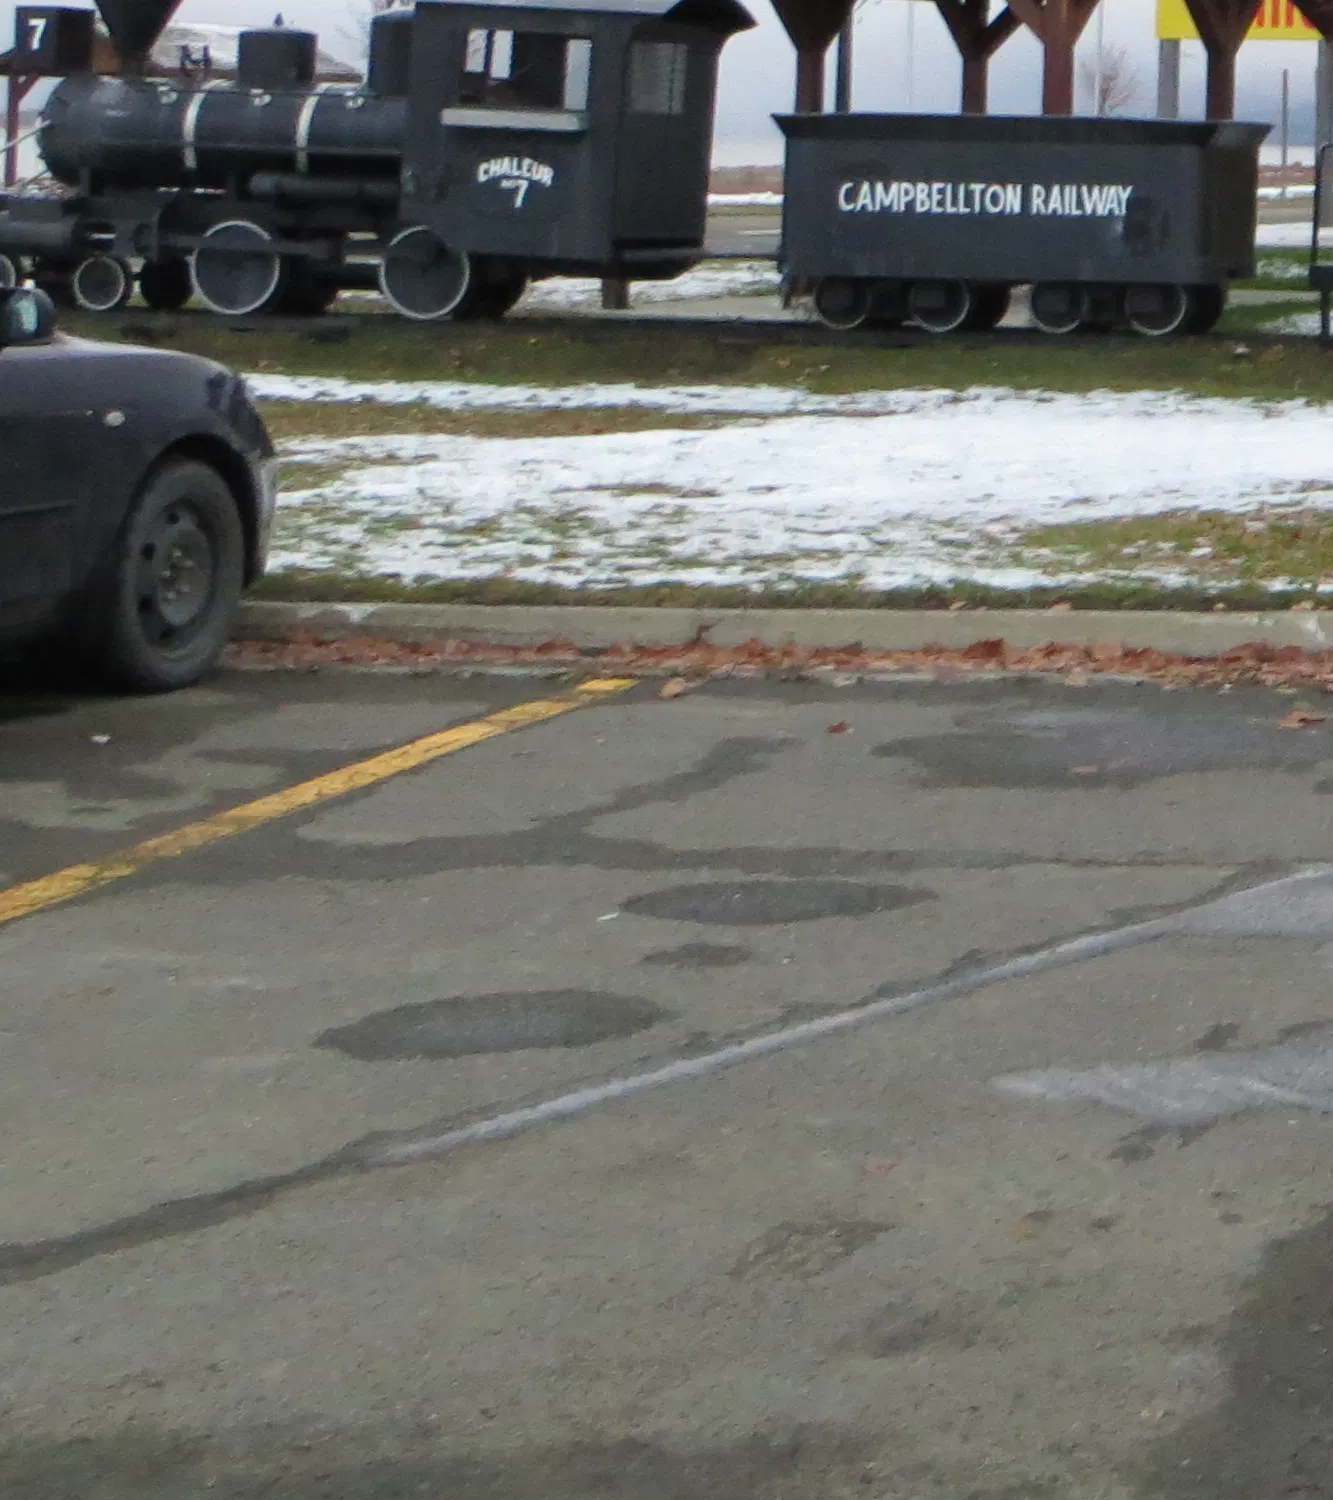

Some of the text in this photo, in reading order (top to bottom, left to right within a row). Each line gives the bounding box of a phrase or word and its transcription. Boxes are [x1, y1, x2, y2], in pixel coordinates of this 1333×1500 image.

[28, 17, 47, 51] 7
[477, 156, 554, 188] CHALEUR
[837, 180, 1134, 216] CAMPBELLTON RAILWAY
